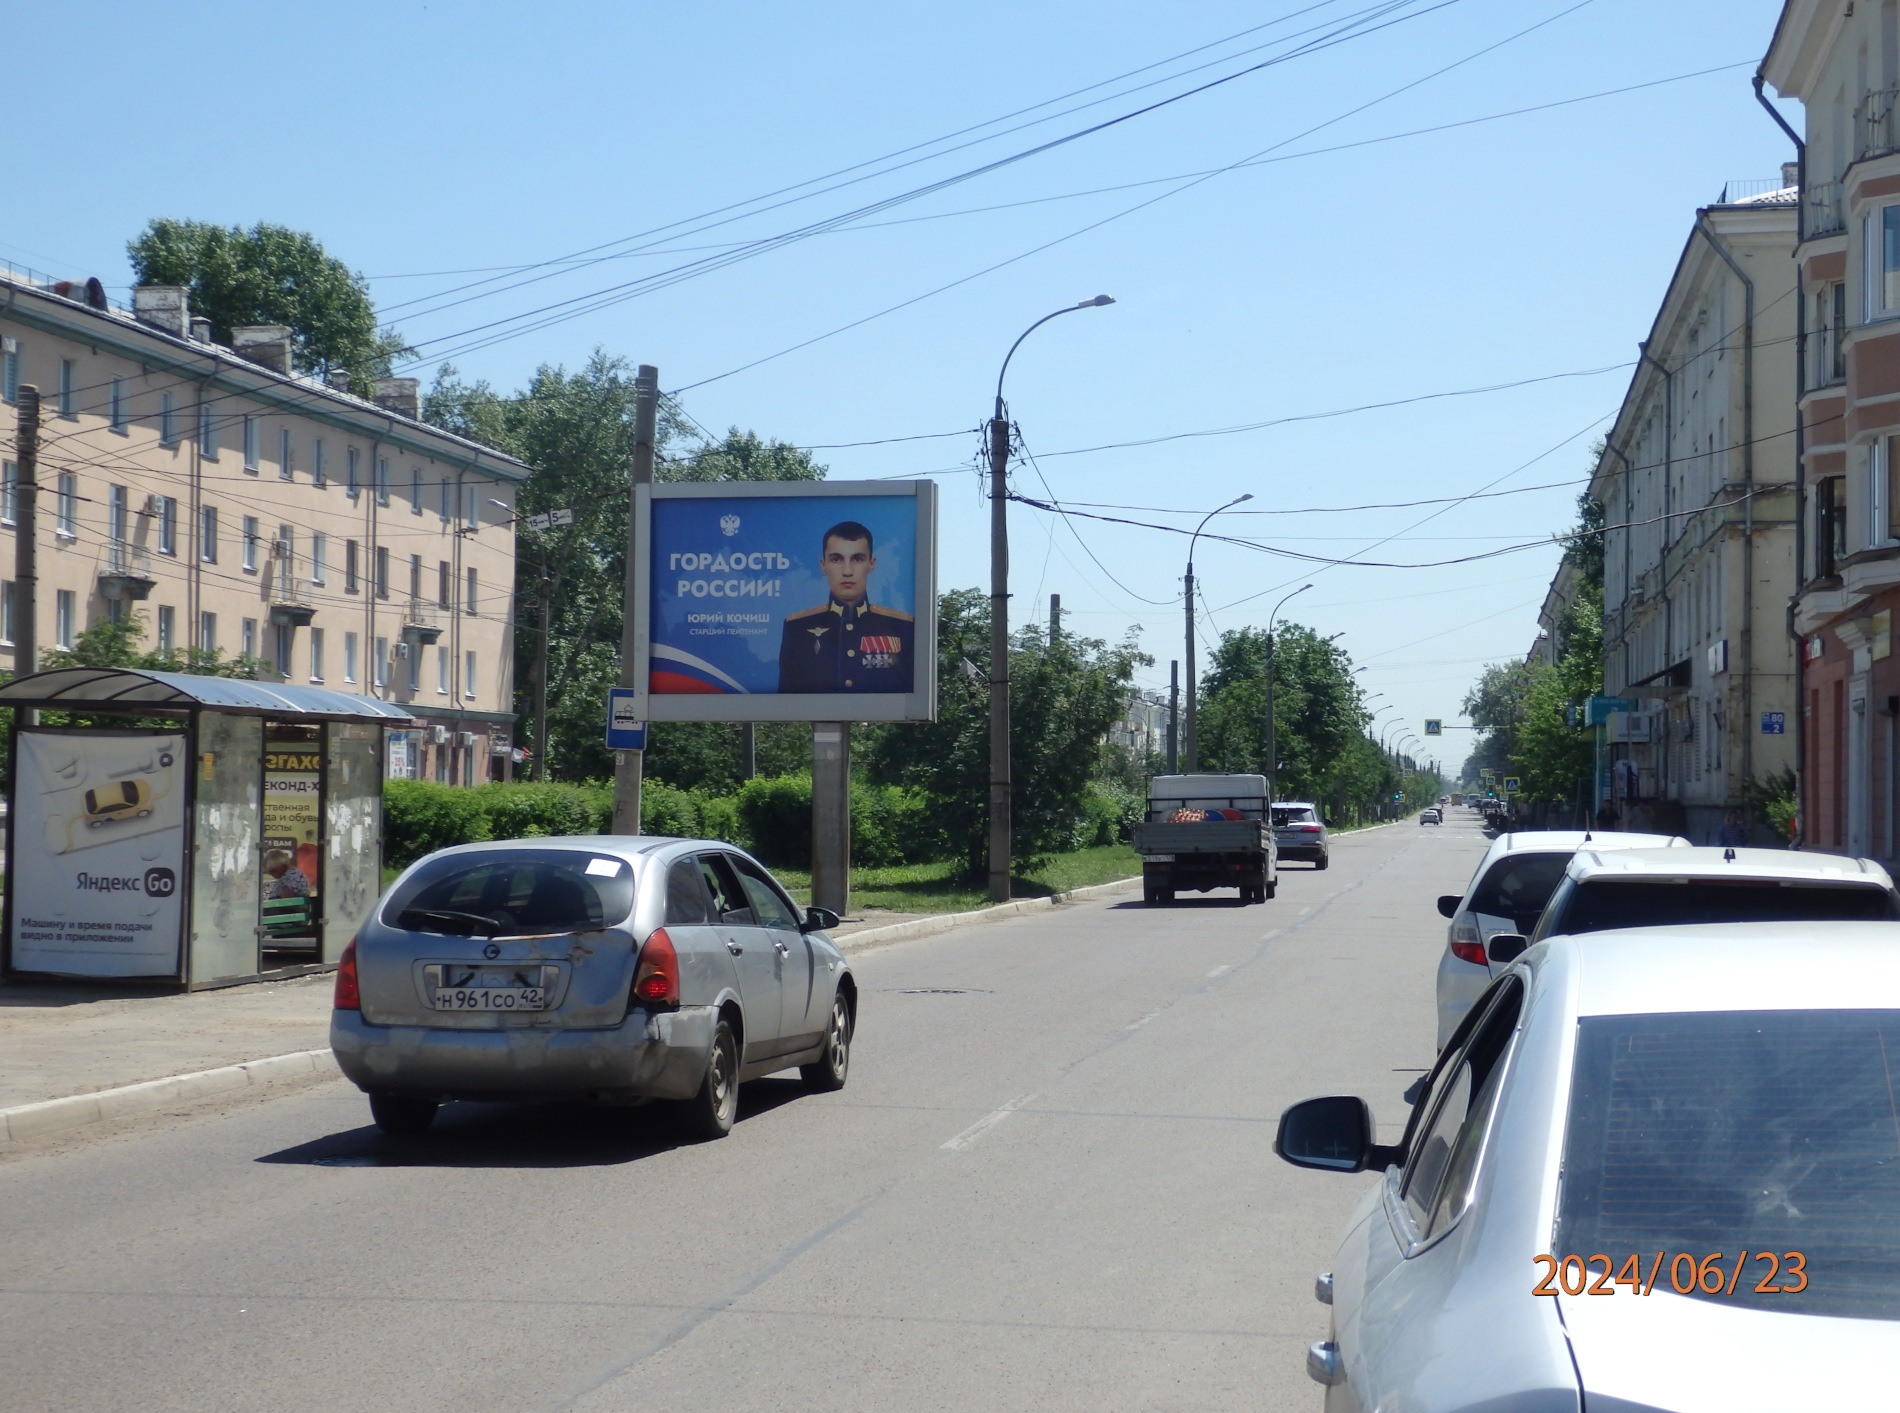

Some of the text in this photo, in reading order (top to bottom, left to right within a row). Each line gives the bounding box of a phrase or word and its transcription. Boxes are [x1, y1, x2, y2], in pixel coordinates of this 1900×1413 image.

[670, 552, 790, 573] ГОРДОСТЬ
[677, 579, 781, 597] РОССИИ!
[687, 611, 770, 623] ЮРИЙ КОЧИШ
[689, 627, 768, 636] СТАРШИЙ ЛЕЙТЕНАНТ
[1771, 713, 1783, 723] 80
[1773, 724, 1780, 733] 2
[76, 872, 172, 893] Яндекс Go
[20, 917, 66, 931] Машину
[77, 922, 112, 933] время
[114, 922, 153, 932] подачи
[20, 931, 134, 943] видно в приложении
[520, 989, 538, 1003] 42
